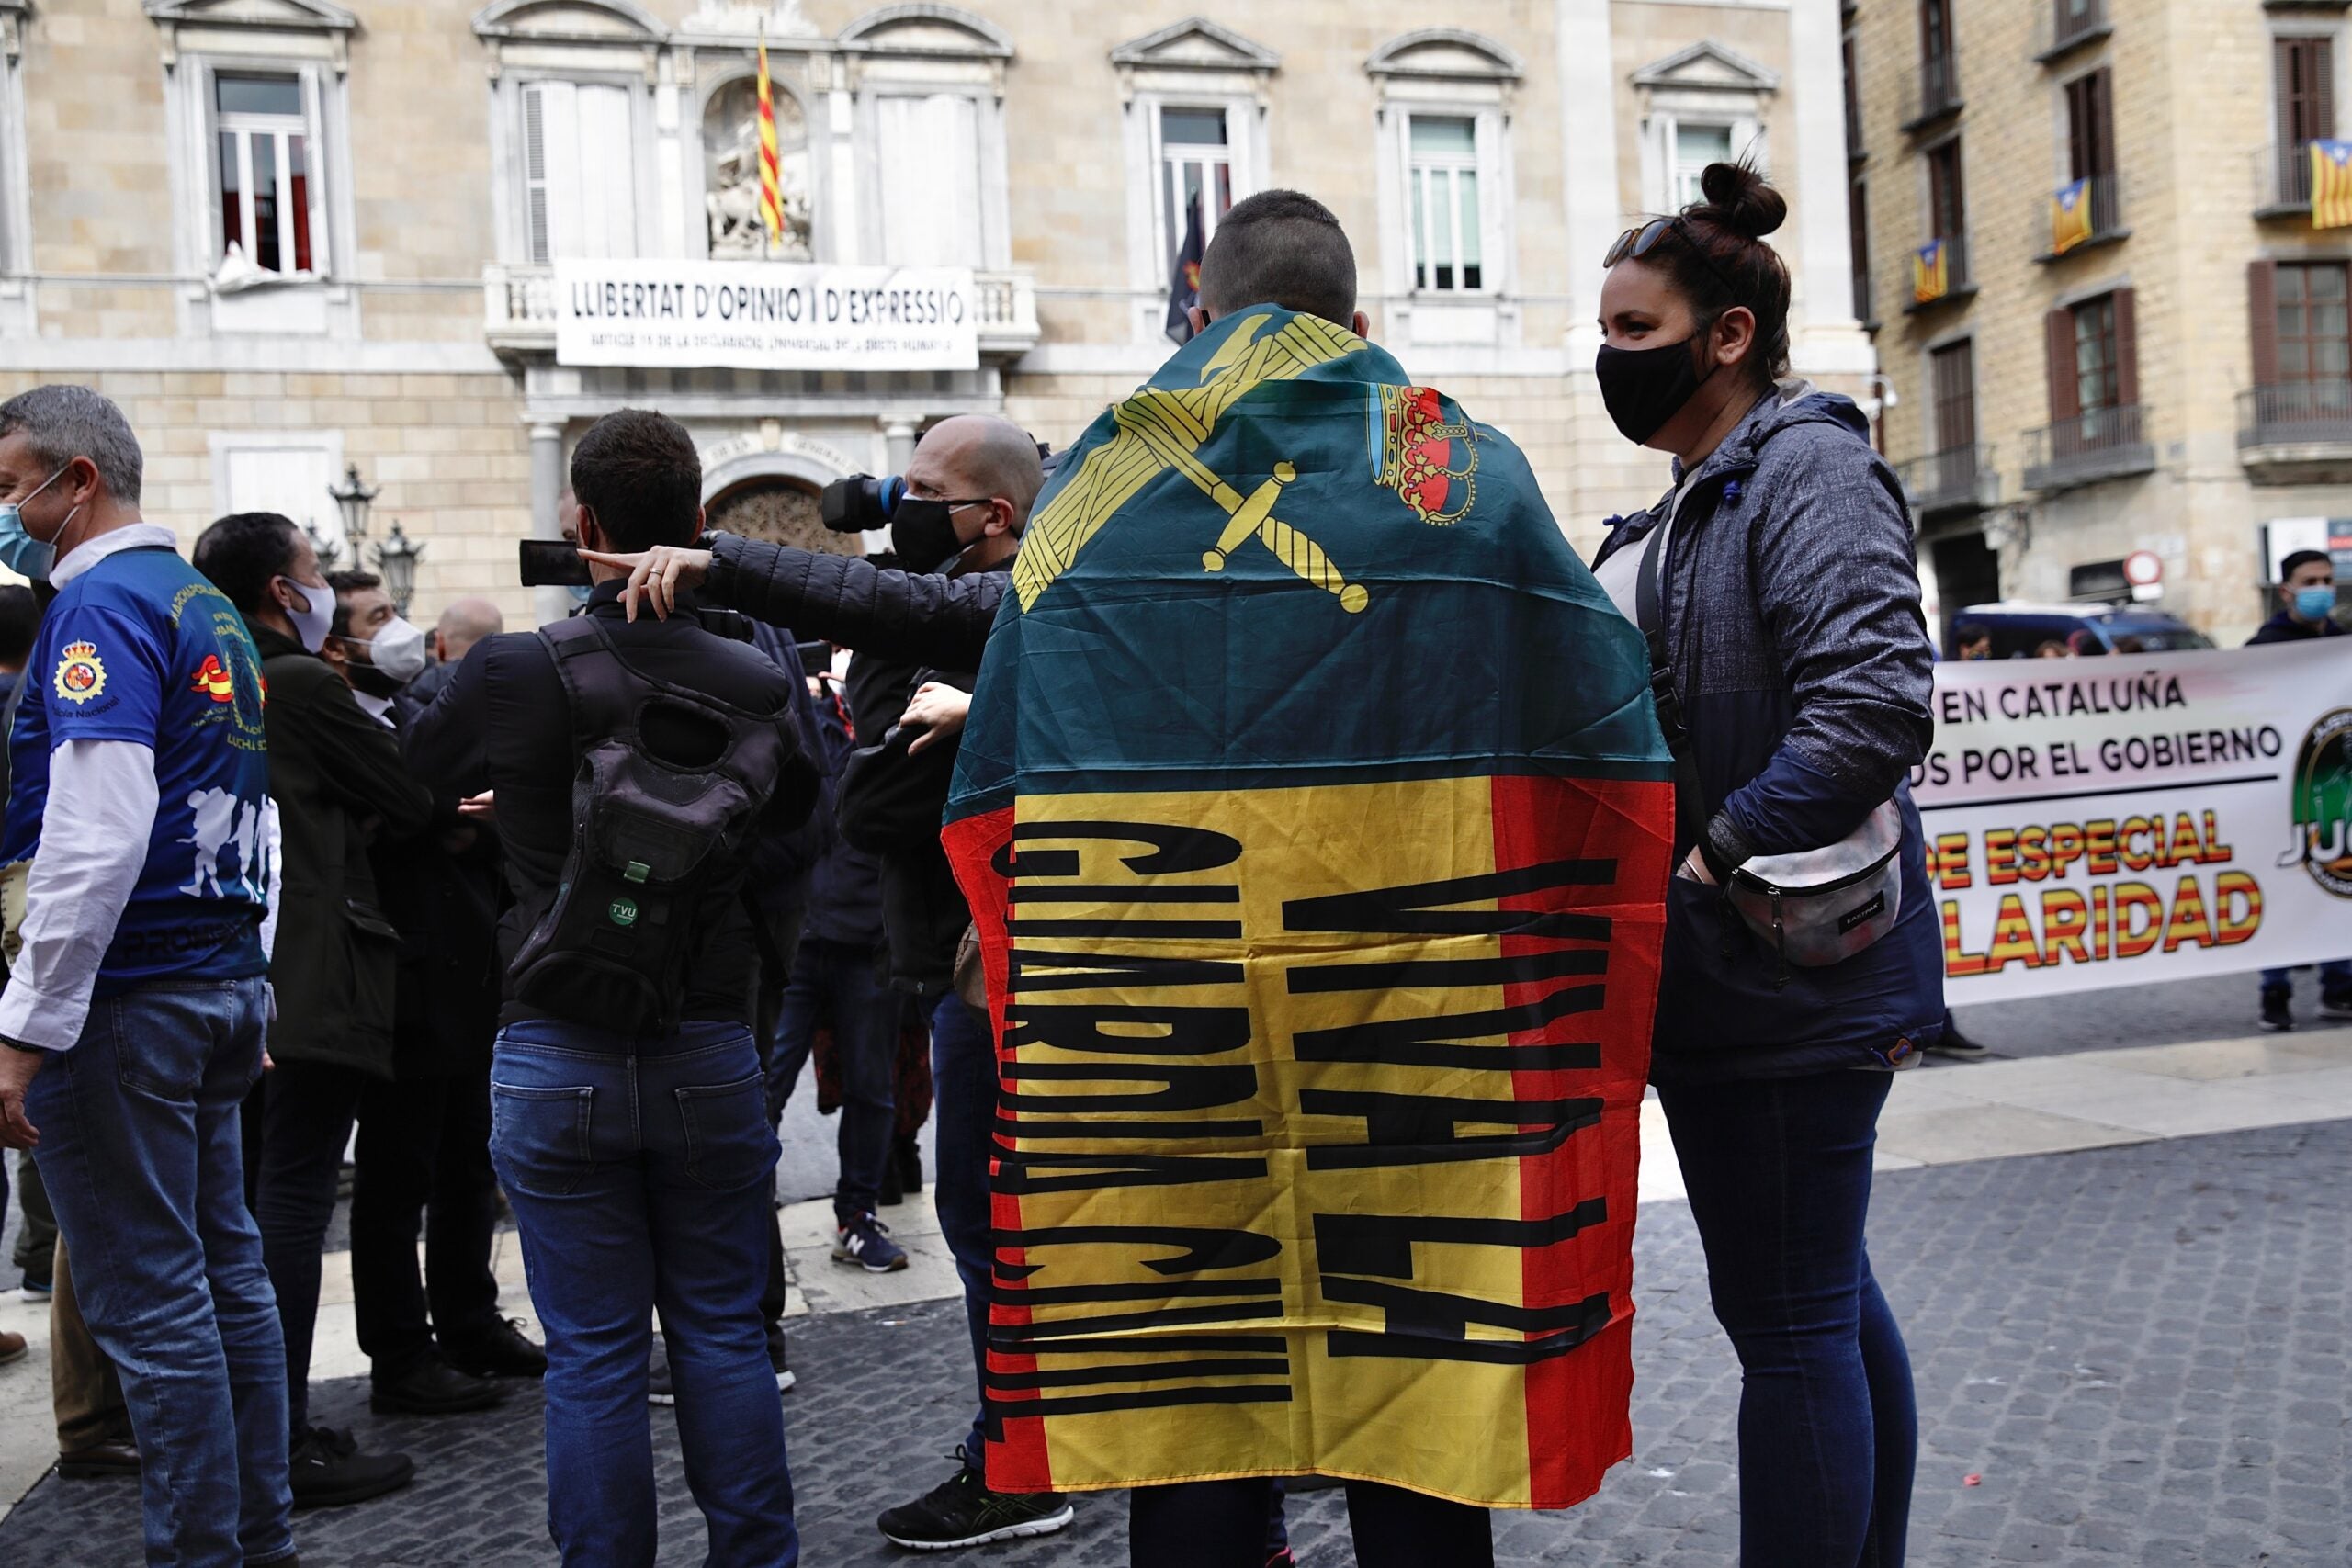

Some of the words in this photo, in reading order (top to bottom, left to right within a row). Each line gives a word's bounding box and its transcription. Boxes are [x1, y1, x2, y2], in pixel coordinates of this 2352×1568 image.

[571, 282, 684, 319] LLIBERTAT
[809, 287, 819, 323] I
[1943, 690, 1987, 724] EN
[1999, 670, 2187, 719] CATALUÑA
[1964, 746, 2039, 784] POR
[2051, 742, 2090, 776] EL
[2099, 724, 2283, 772] GOBIERNO
[1984, 808, 2233, 886] ESPECIAL
[612, 903, 637, 917] TVU
[1943, 870, 2263, 978] LARIDAD
[990, 820, 1269, 1197] GUARDIA
[1282, 858, 1619, 1171] VIVA
[1312, 1198, 1611, 1365] LA
[986, 1225, 1293, 1443] CIVIL
